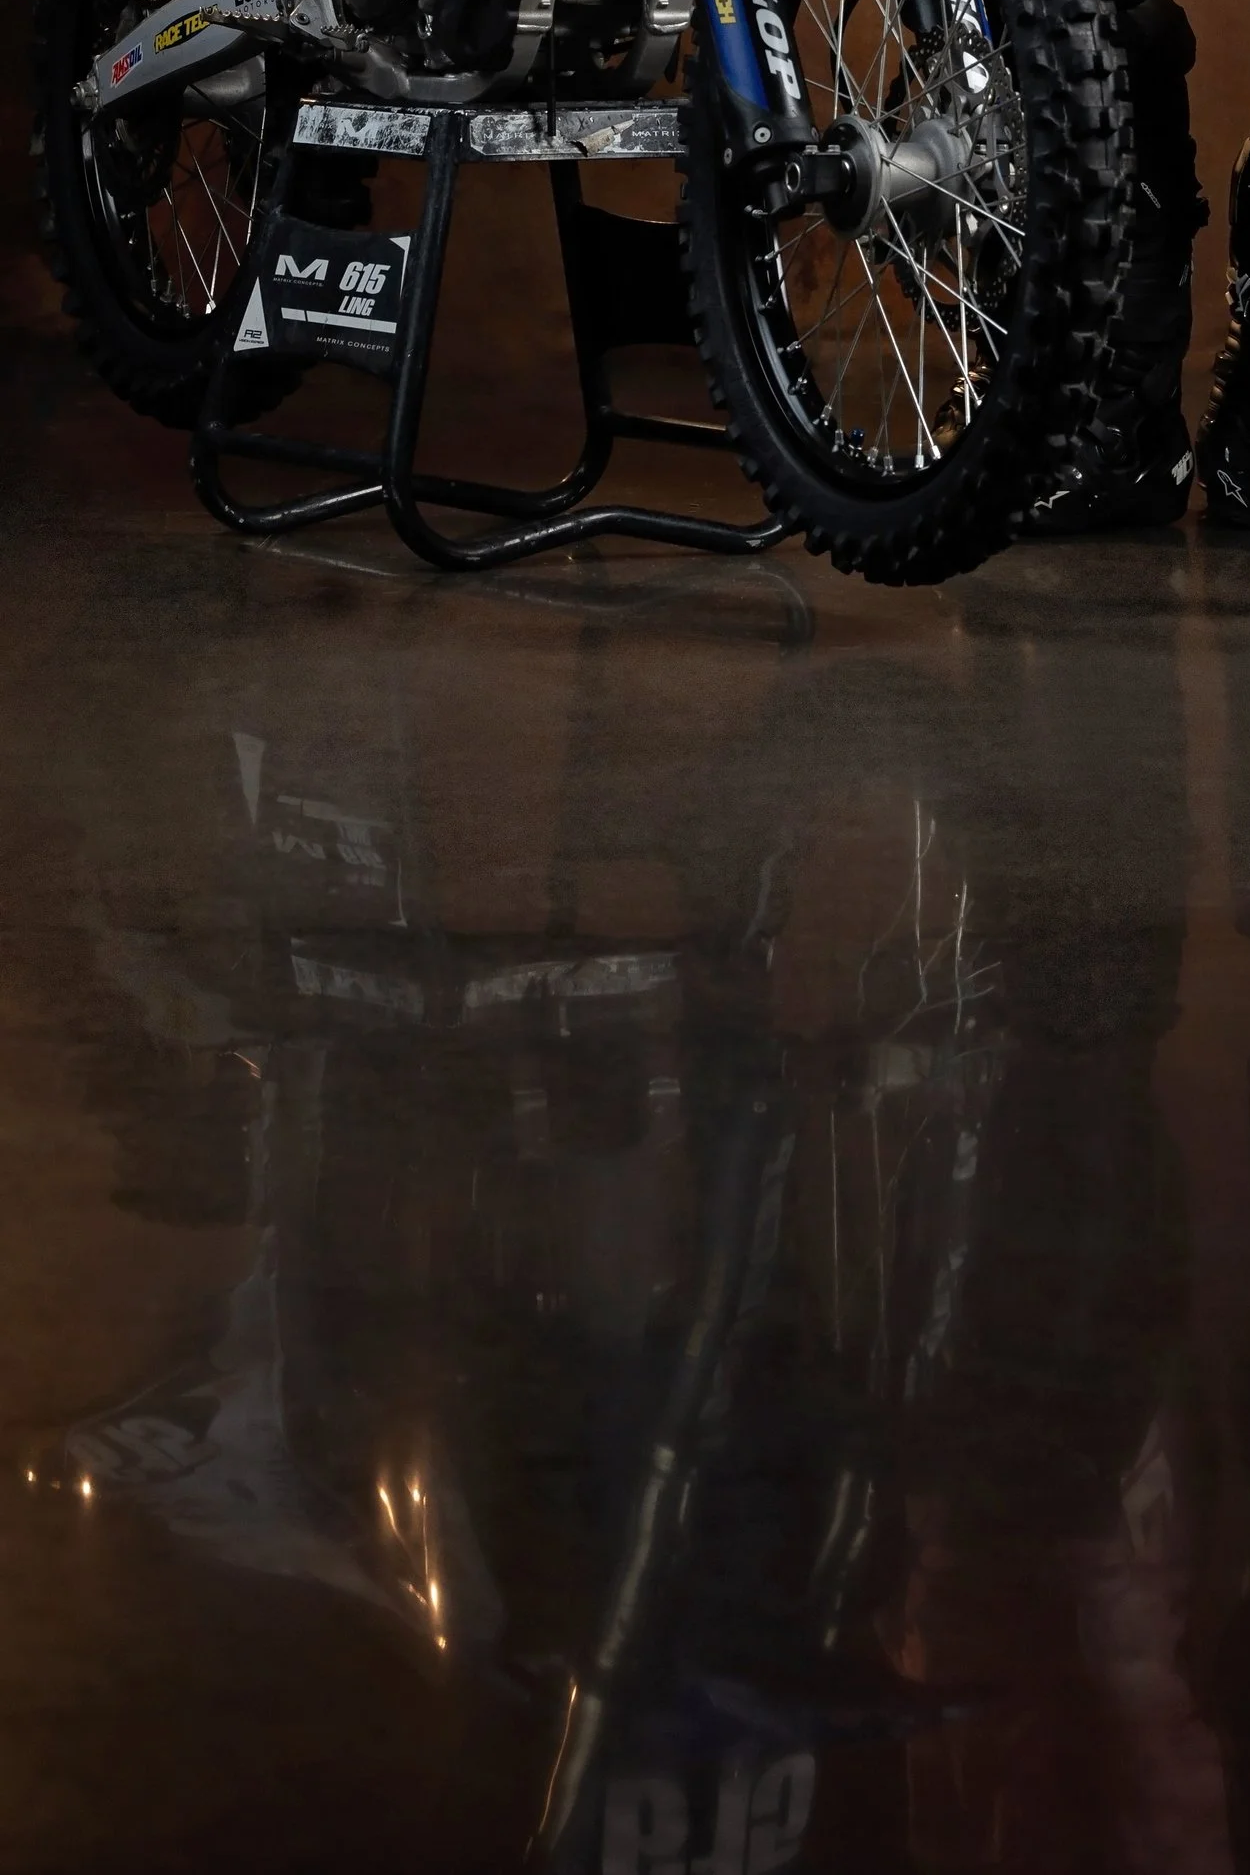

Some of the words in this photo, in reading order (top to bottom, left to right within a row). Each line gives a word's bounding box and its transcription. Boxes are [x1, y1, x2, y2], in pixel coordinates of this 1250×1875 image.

[154, 20, 183, 54] RACE
[111, 44, 143, 85] AMSOIL
[339, 261, 391, 295] 615
[338, 295, 376, 316] LING
[316, 336, 345, 346] MATRIX
[347, 340, 390, 352] CONCEPTS
